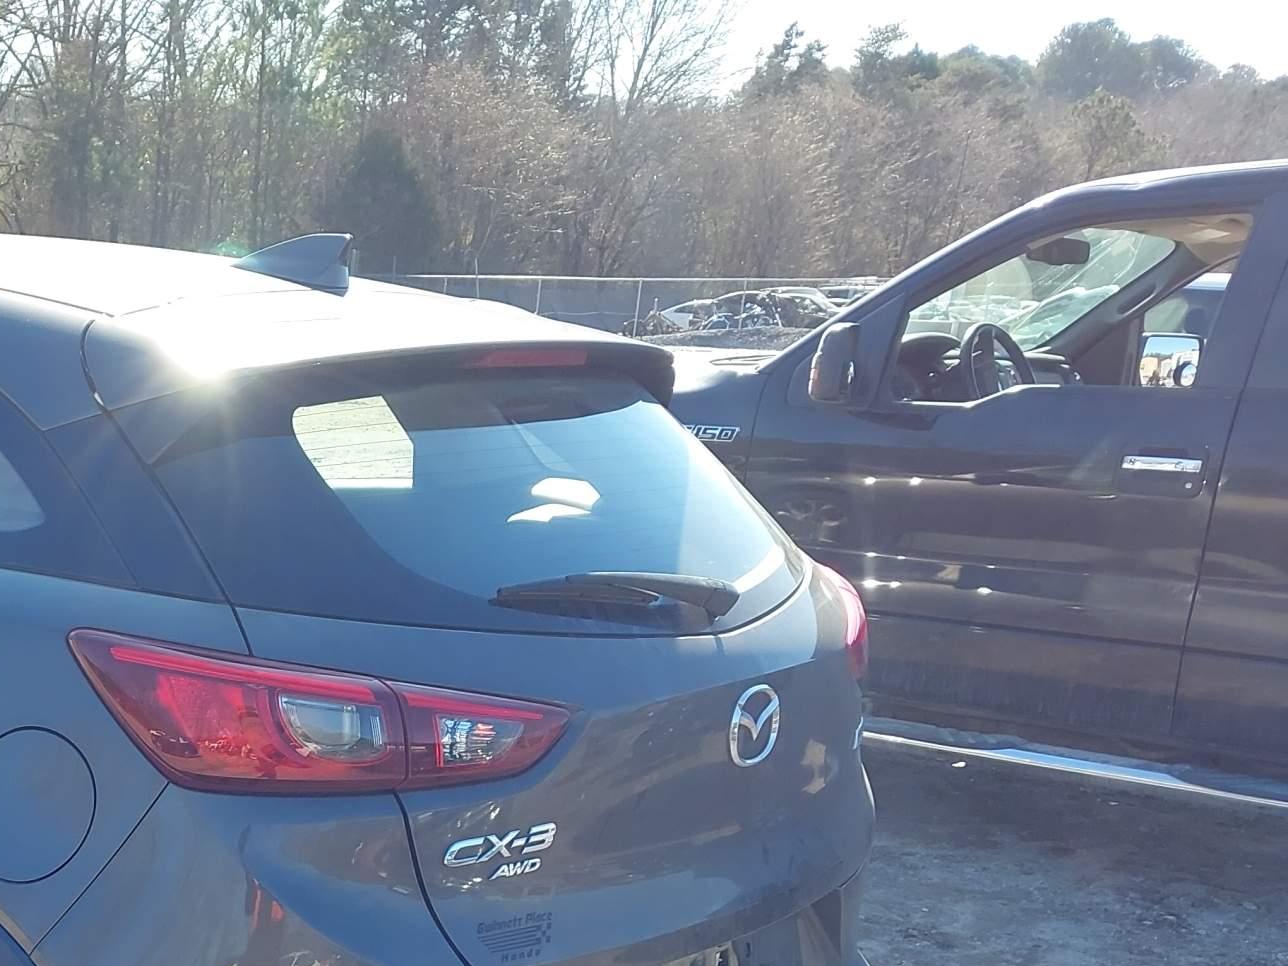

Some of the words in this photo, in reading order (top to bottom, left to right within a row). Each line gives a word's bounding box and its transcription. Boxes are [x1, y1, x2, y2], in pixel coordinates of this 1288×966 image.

[443, 822, 557, 867] CX-3
[488, 857, 542, 881] AWD
[500, 949, 542, 963] Honda
